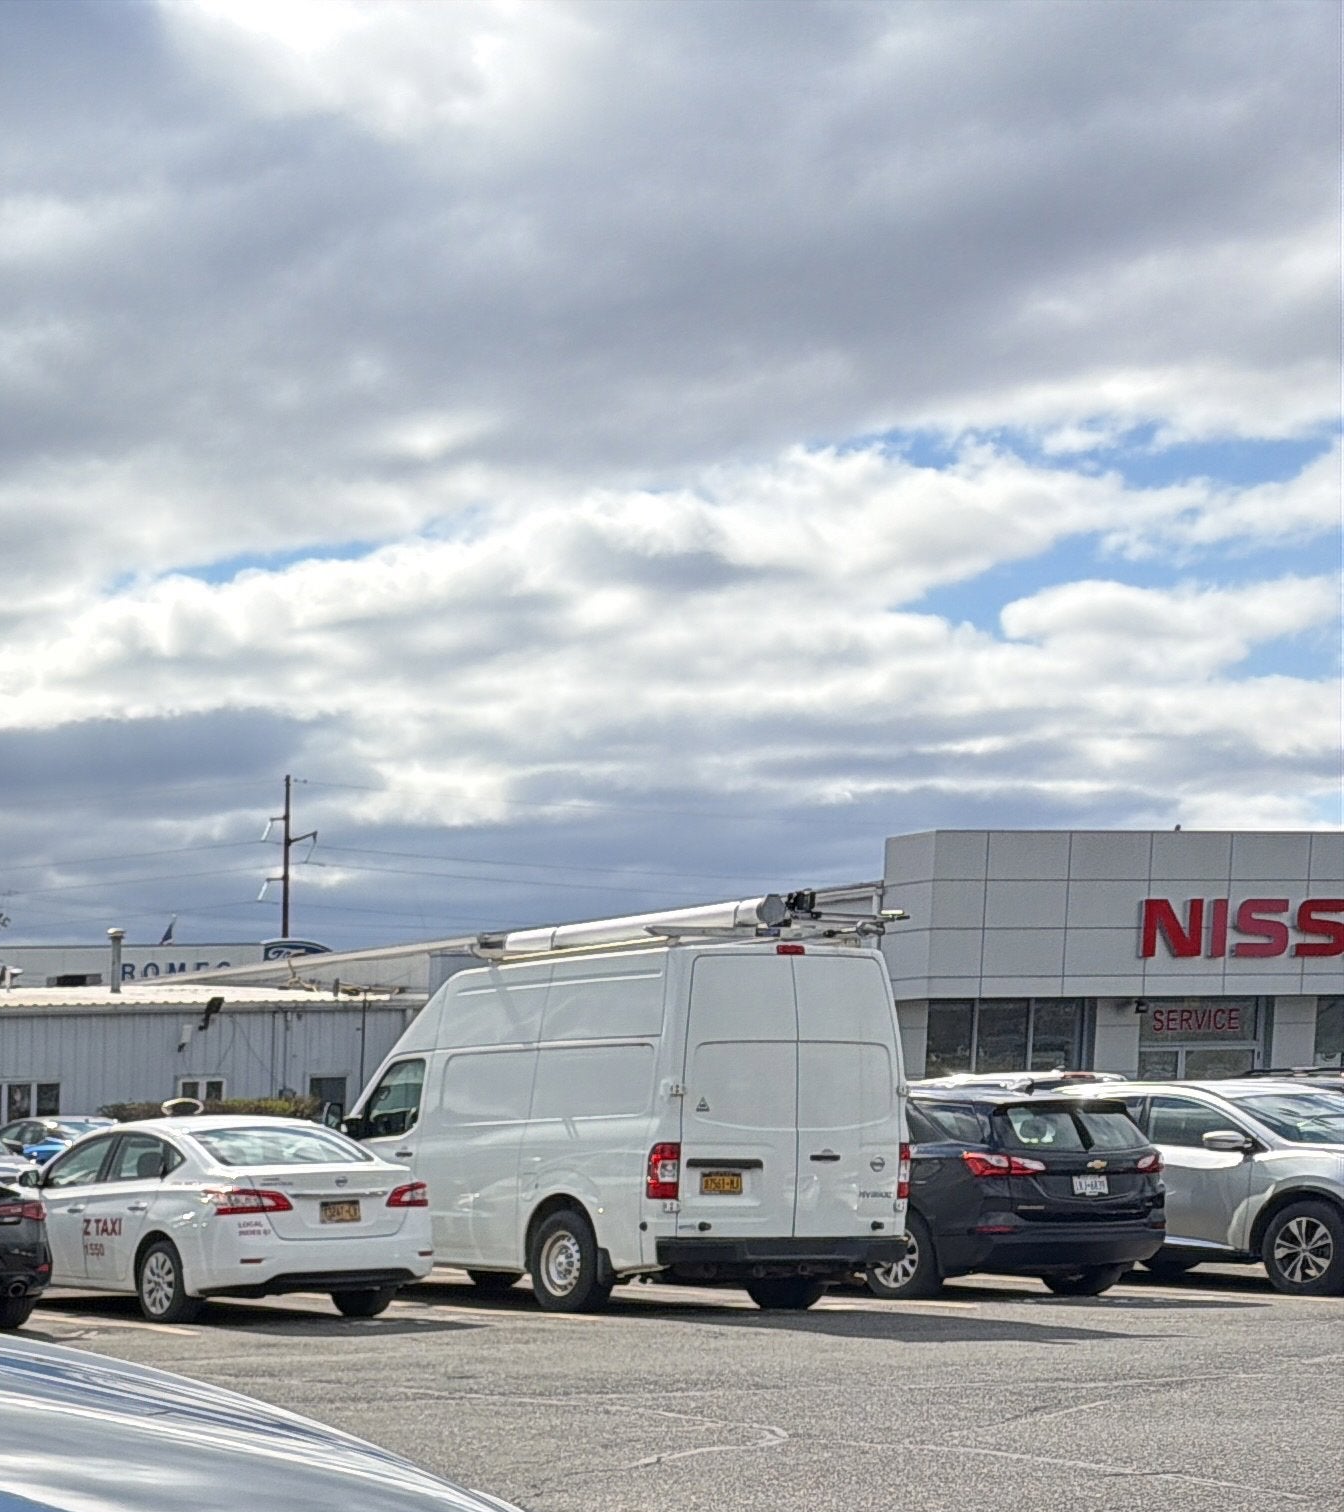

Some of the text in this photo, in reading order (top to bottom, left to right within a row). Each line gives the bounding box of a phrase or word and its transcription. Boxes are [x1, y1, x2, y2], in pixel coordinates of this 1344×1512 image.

[121, 961, 231, 981] ROM
[1152, 1008, 1240, 1032] SERVICE
[94, 1217, 122, 1236] TAXI
